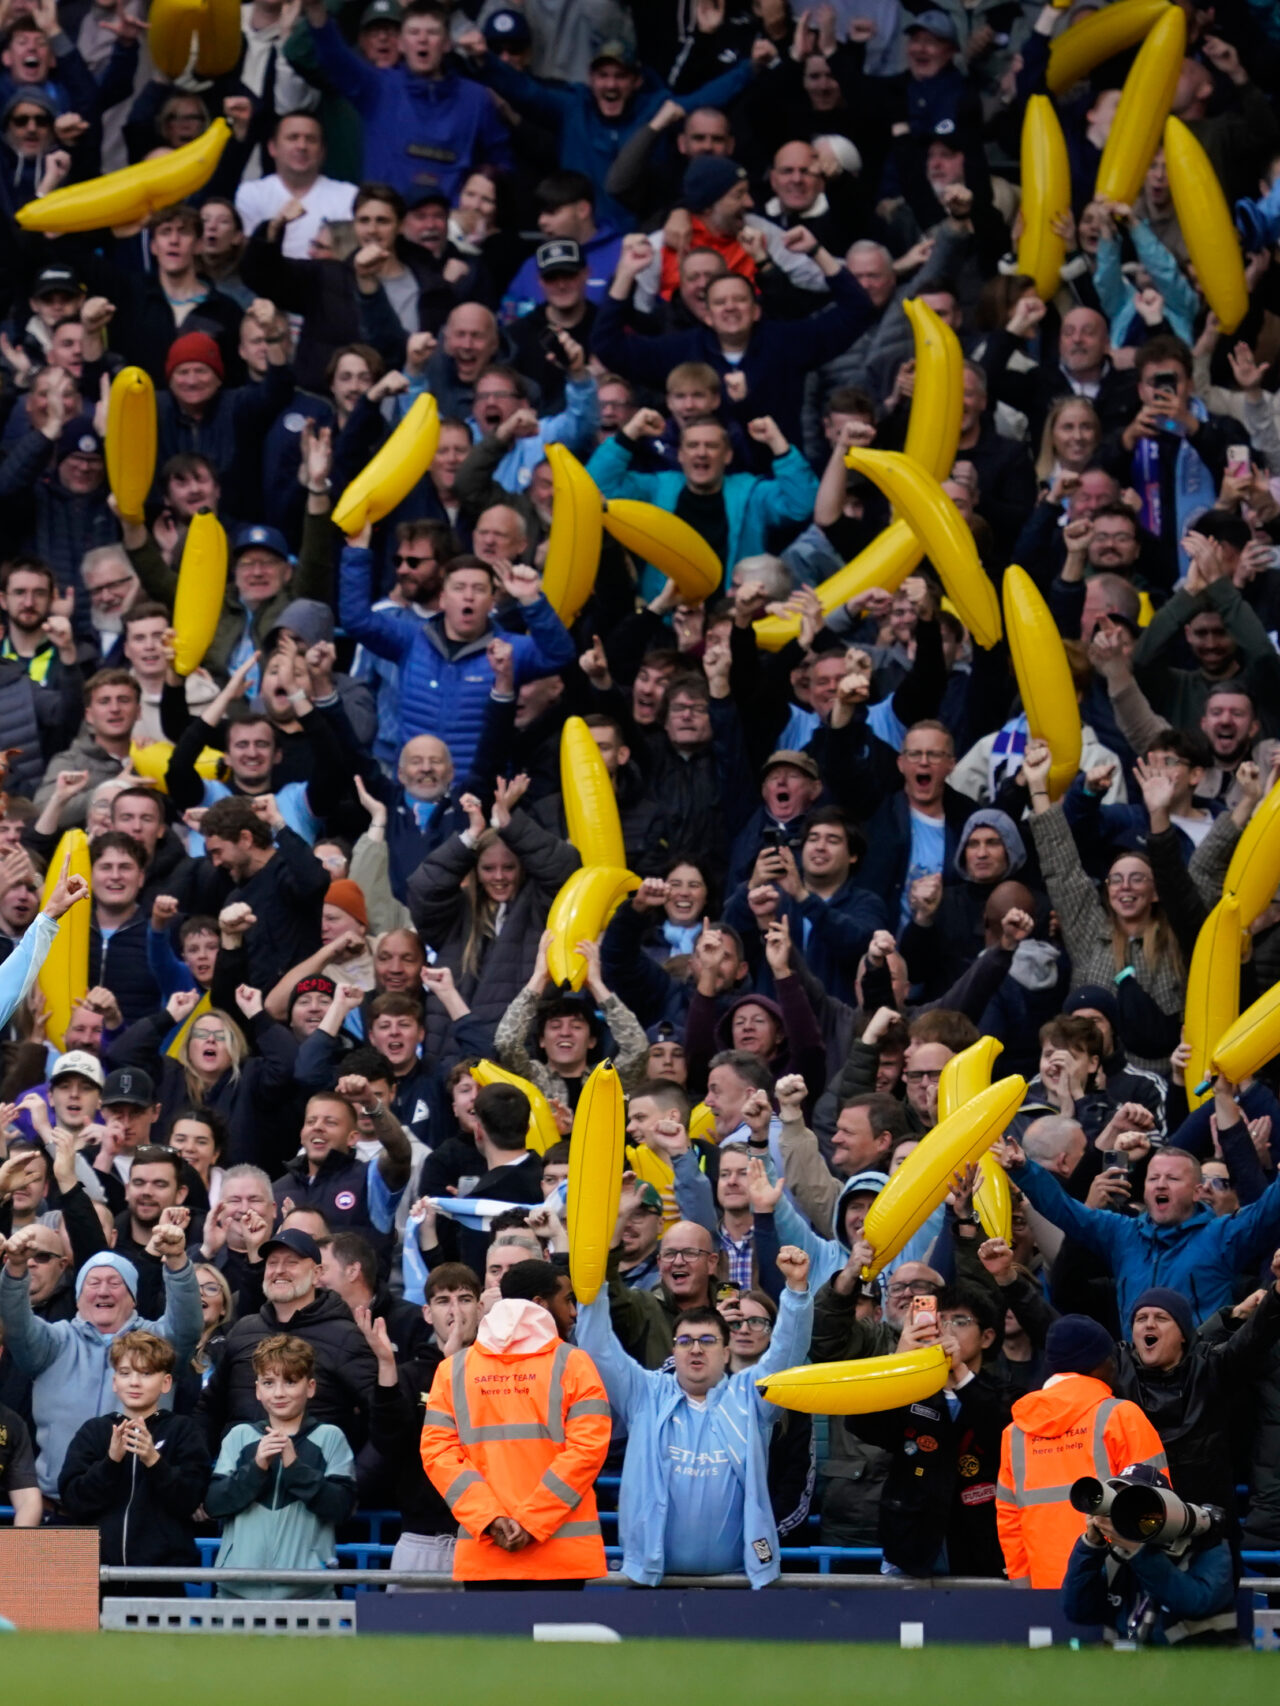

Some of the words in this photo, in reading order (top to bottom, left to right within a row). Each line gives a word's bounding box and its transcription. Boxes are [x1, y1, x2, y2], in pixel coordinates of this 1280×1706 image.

[474, 1374, 510, 1384] SAFETY
[512, 1373, 537, 1382] TEAM
[480, 1387, 500, 1396] here
[1065, 1427, 1088, 1438] TEAM
[1032, 1447, 1053, 1455] here
[1065, 1441, 1083, 1450] help
